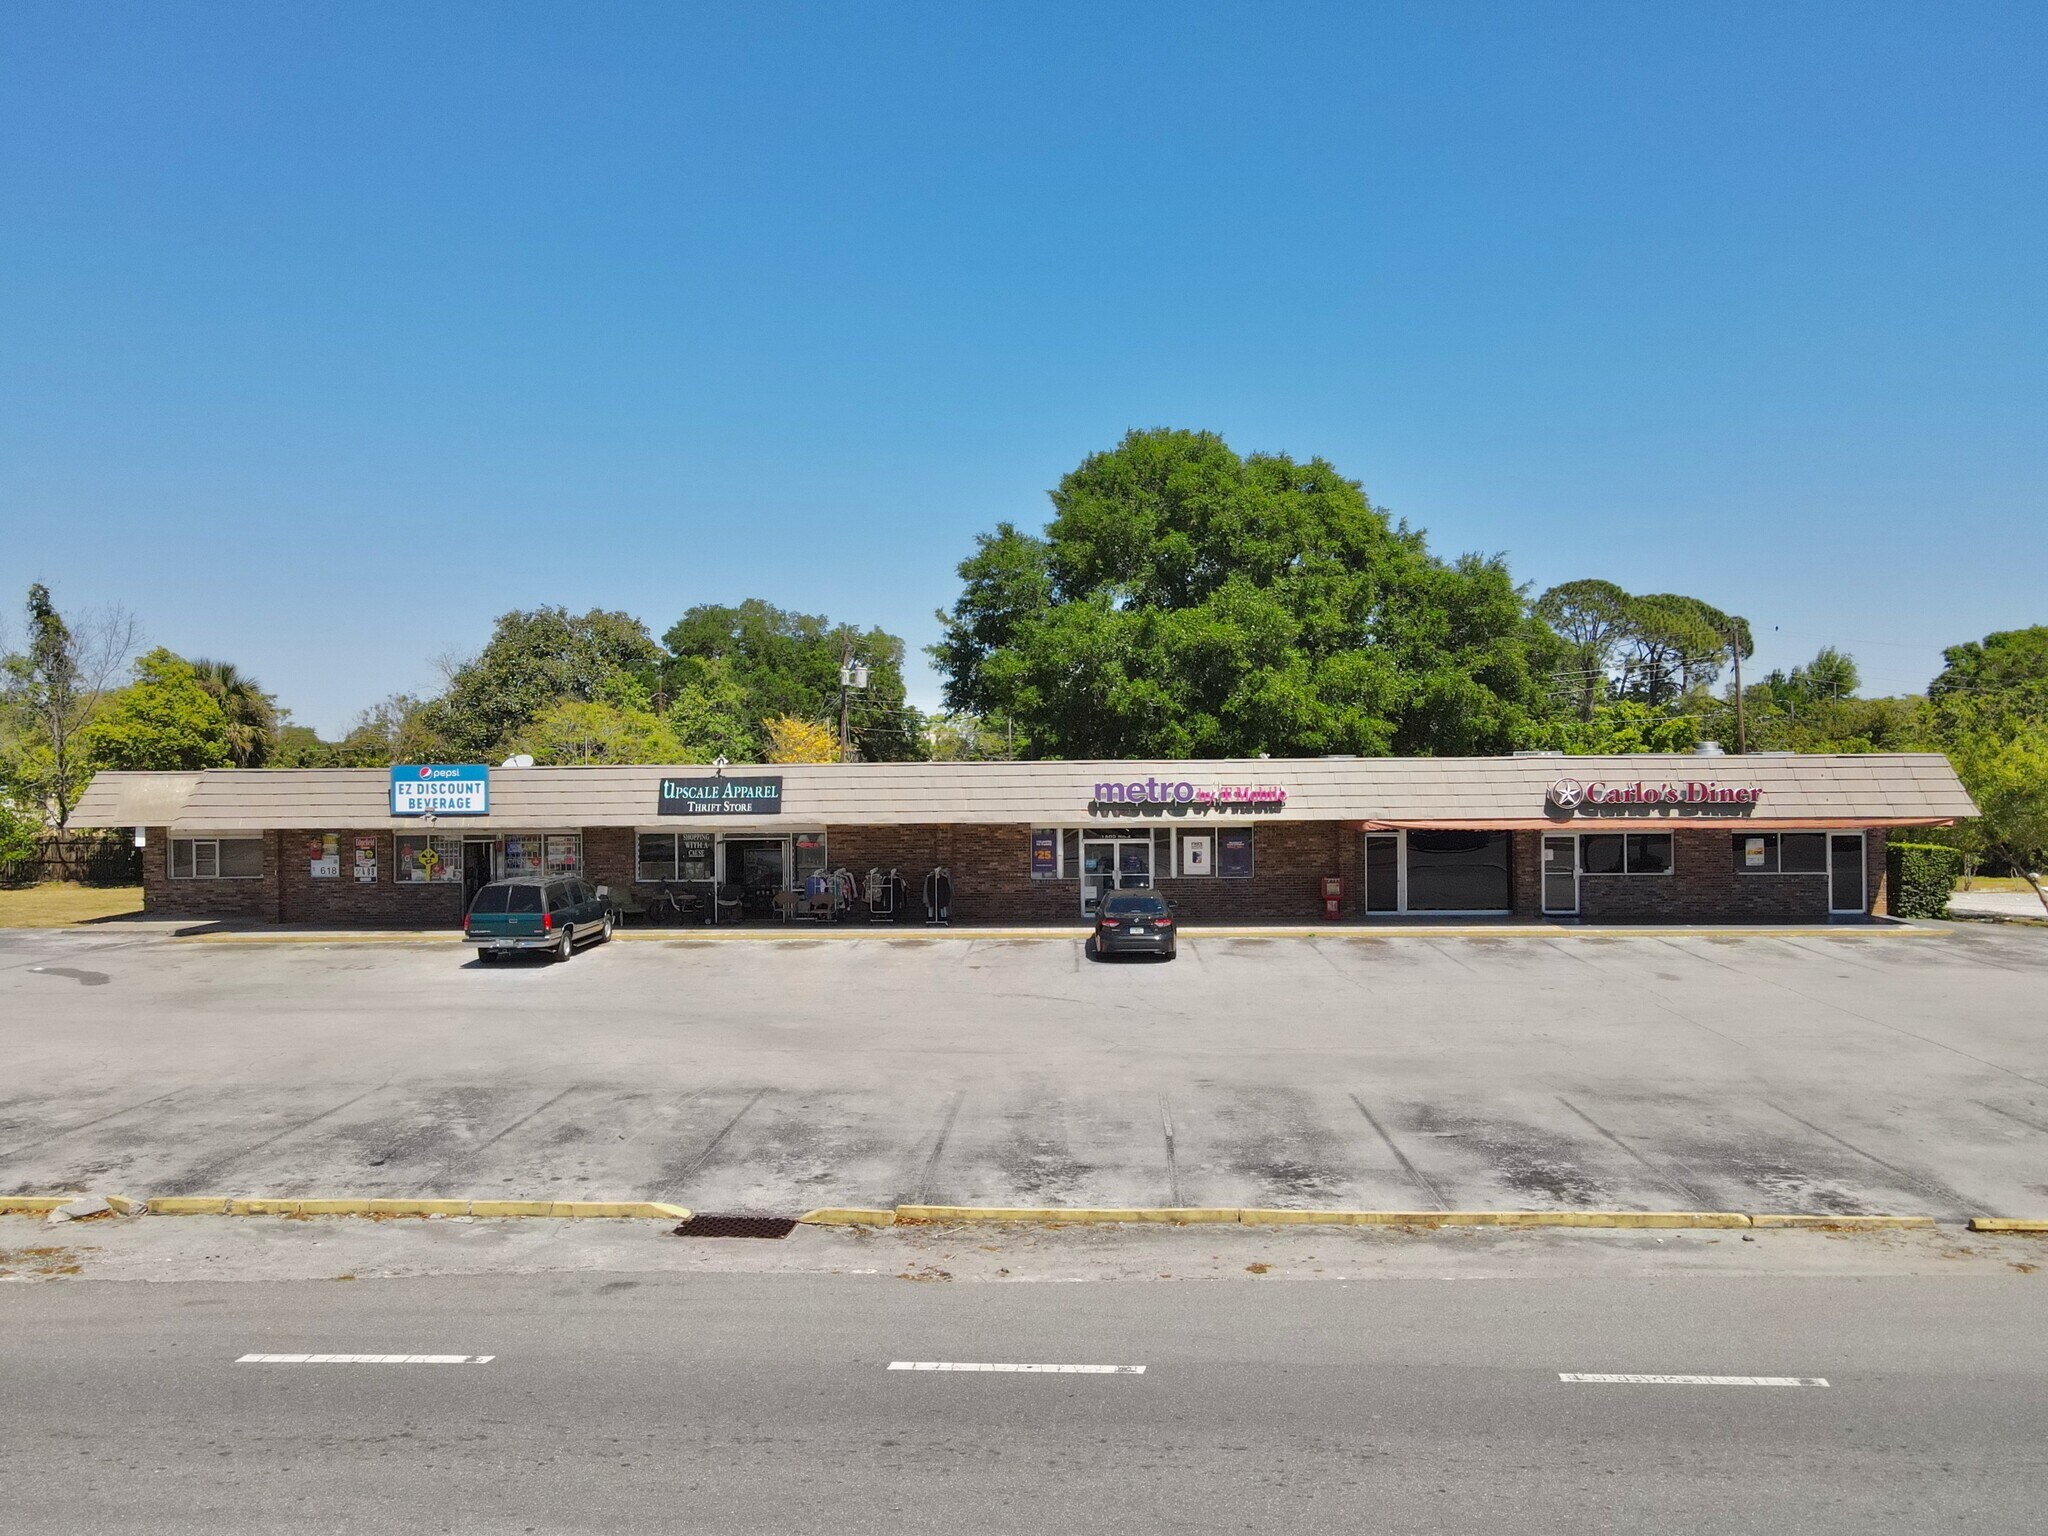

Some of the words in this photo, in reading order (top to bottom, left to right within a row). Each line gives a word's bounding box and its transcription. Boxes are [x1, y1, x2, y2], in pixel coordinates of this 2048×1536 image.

[433, 769, 460, 779] pepsi
[398, 783, 412, 795] EZ
[417, 783, 481, 795] DISCOUNT
[1094, 777, 1194, 803] metro
[1586, 781, 1677, 804] Carlo's
[1686, 782, 1762, 804] Diner
[408, 797, 471, 809] BEVERAGE
[684, 841, 701, 849] WITH
[702, 841, 709, 849] A
[320, 866, 337, 875] 618
